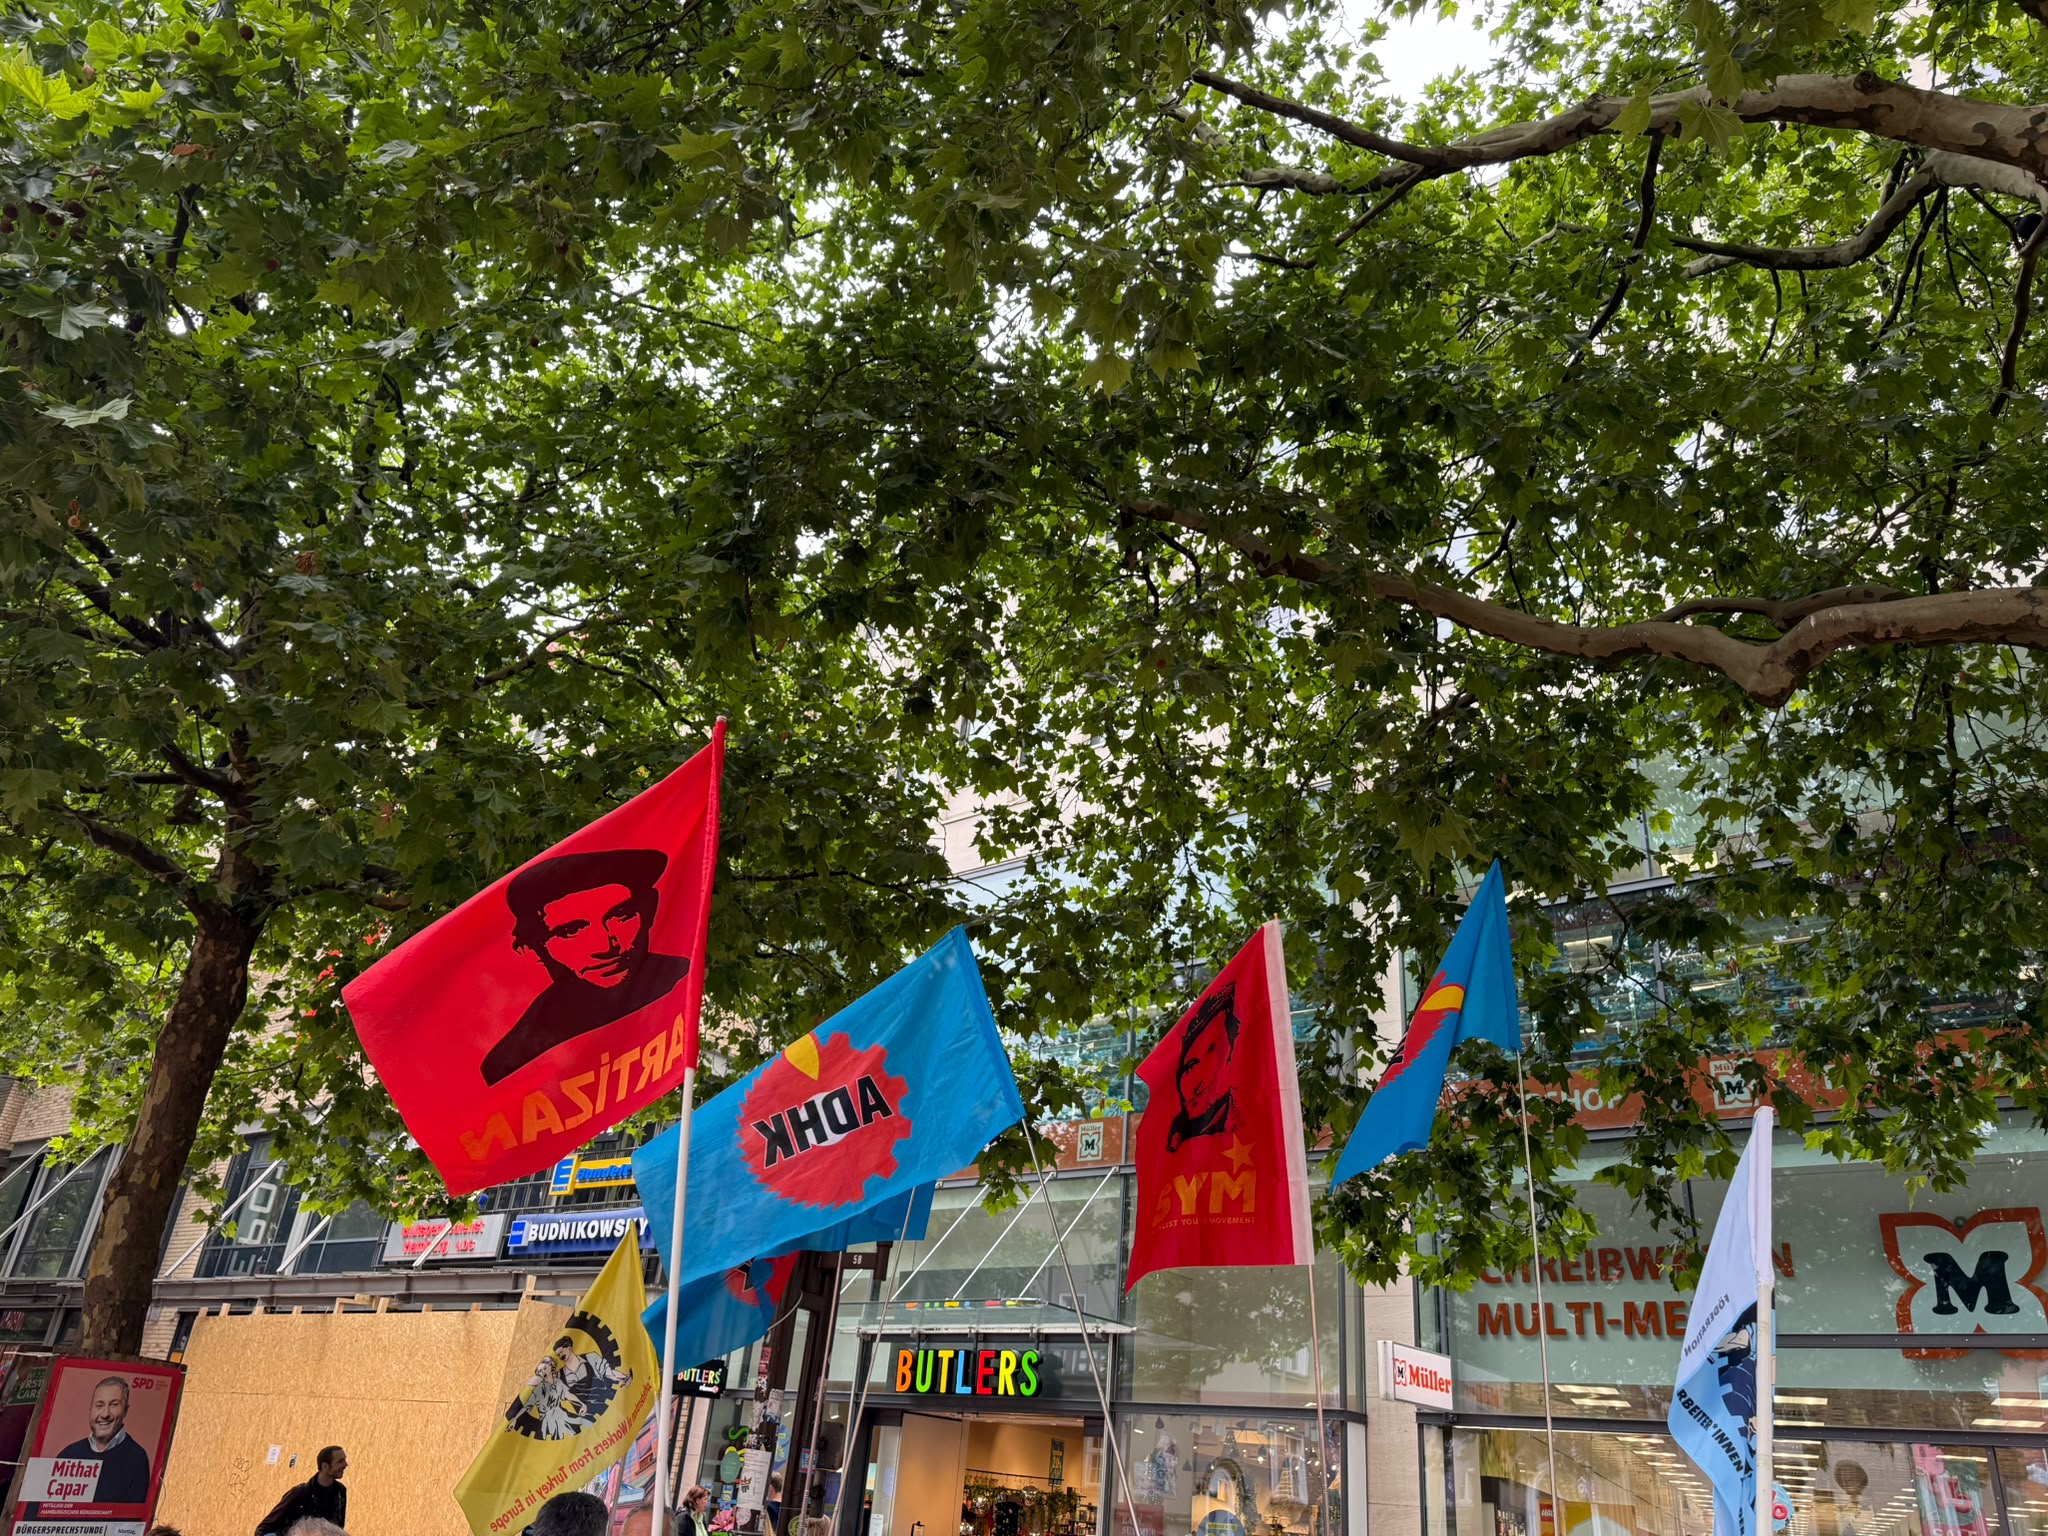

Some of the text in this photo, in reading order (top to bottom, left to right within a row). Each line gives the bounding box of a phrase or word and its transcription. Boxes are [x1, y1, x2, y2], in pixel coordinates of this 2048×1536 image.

[853, 1254, 863, 1265] 58
[1478, 1301, 1692, 1337] MULTI-ME
[677, 1367, 721, 1385] BUTLERS
[895, 1349, 1040, 1397] BUTLERS
[1408, 1363, 1452, 1394] Müller
[131, 1377, 154, 1390] SPD
[1676, 1388, 1743, 1473] RBEITERINNEN
[52, 1460, 100, 1478] Mithat
[47, 1479, 89, 1500] Çapar
[16, 1524, 104, 1535] BÜRGERSPRECHSTUNDE
